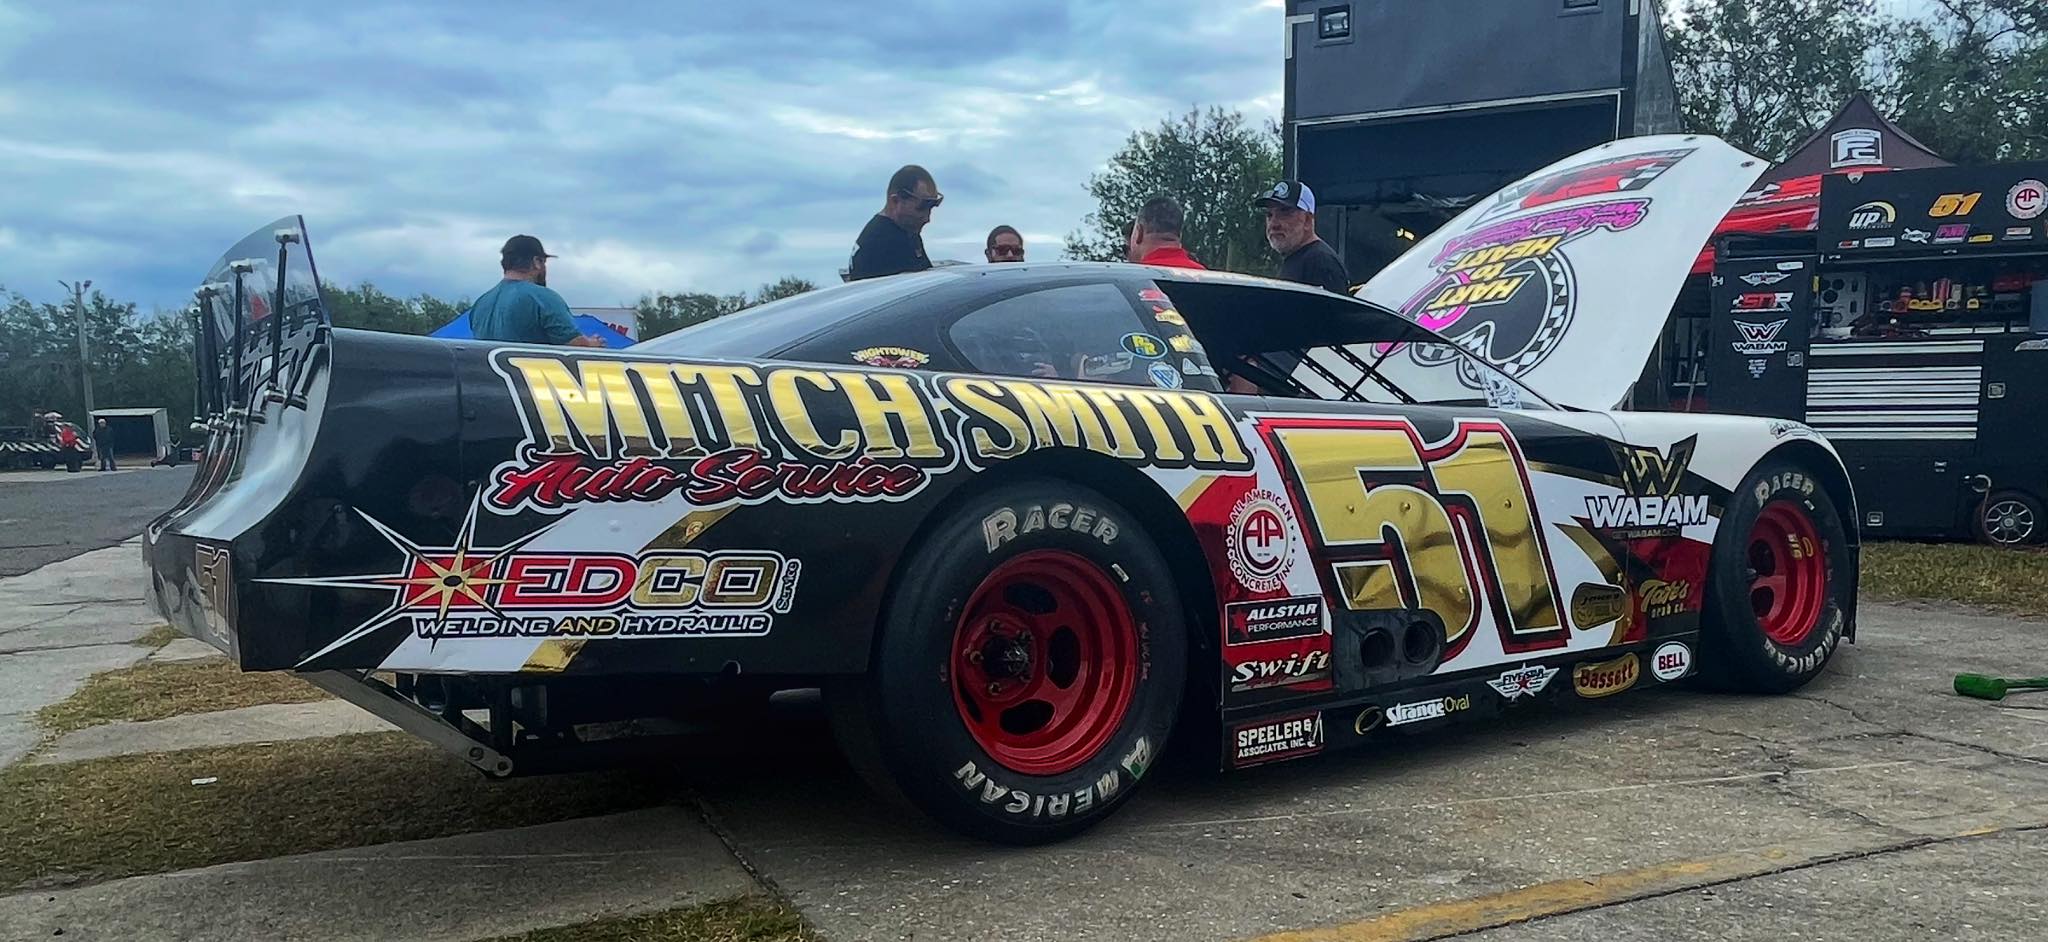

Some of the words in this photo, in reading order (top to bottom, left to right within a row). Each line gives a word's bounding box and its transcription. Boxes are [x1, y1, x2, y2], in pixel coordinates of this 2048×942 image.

[1849, 212, 1881, 228] UP
[1929, 193, 1982, 217] 51
[1432, 276, 1524, 308] HART
[1732, 341, 1787, 351] WABAM
[508, 356, 946, 460] MITCH
[945, 377, 1250, 464] SMITH
[494, 448, 686, 505] Auto
[684, 446, 922, 503] Service
[1755, 471, 1815, 509] RACER
[1245, 489, 1294, 522] AMERICAN
[1584, 494, 1710, 529] WABAM
[982, 503, 1119, 554] RACER
[1268, 422, 1568, 652] 51
[776, 560, 800, 613] Service
[1230, 559, 1281, 590] CONCRETE
[416, 616, 549, 636] WELDING
[554, 616, 618, 634] AND
[621, 615, 768, 633] HYDRAULIC
[1246, 603, 1319, 622] ALLSTAR
[1247, 617, 1319, 634] PERFORMANCE
[1580, 660, 1635, 689] Bassett
[1658, 652, 1685, 671] BELL
[1444, 694, 1471, 713] Oval
[1238, 719, 1302, 748] SPEELER
[953, 736, 1151, 817] AMERICAN
